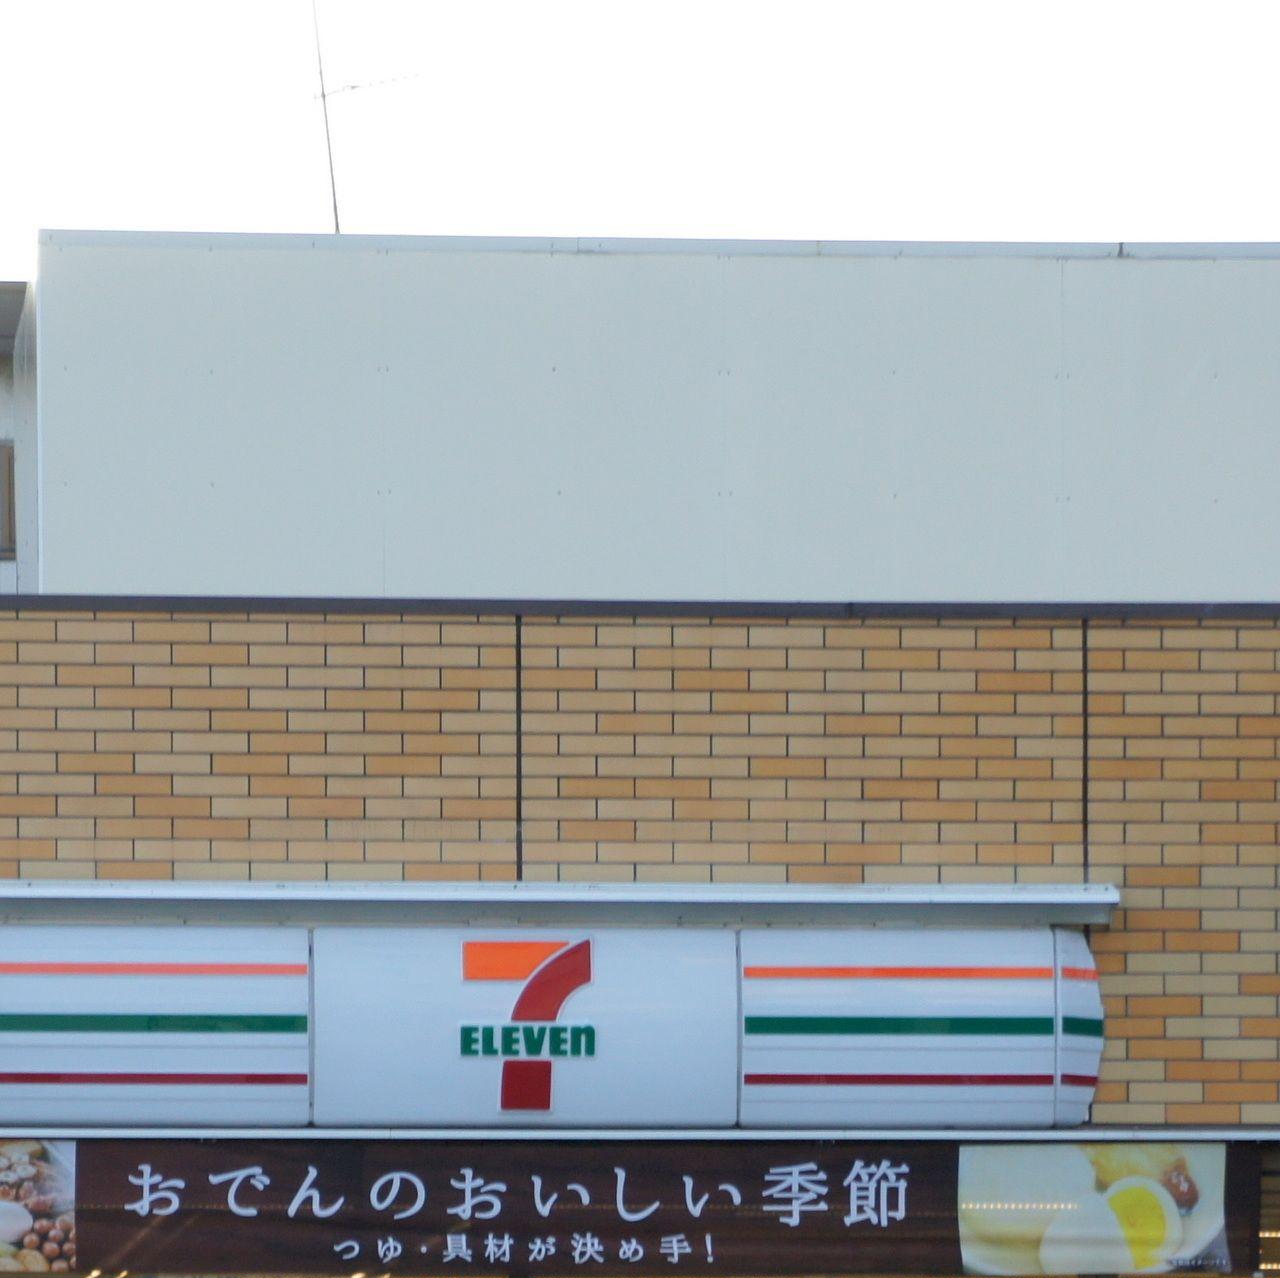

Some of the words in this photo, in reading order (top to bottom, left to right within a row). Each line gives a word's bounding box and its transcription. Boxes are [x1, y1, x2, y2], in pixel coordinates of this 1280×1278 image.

[460, 1025, 596, 1057] ELEVEN
[124, 1158, 910, 1228] おでんのおいしい季節
